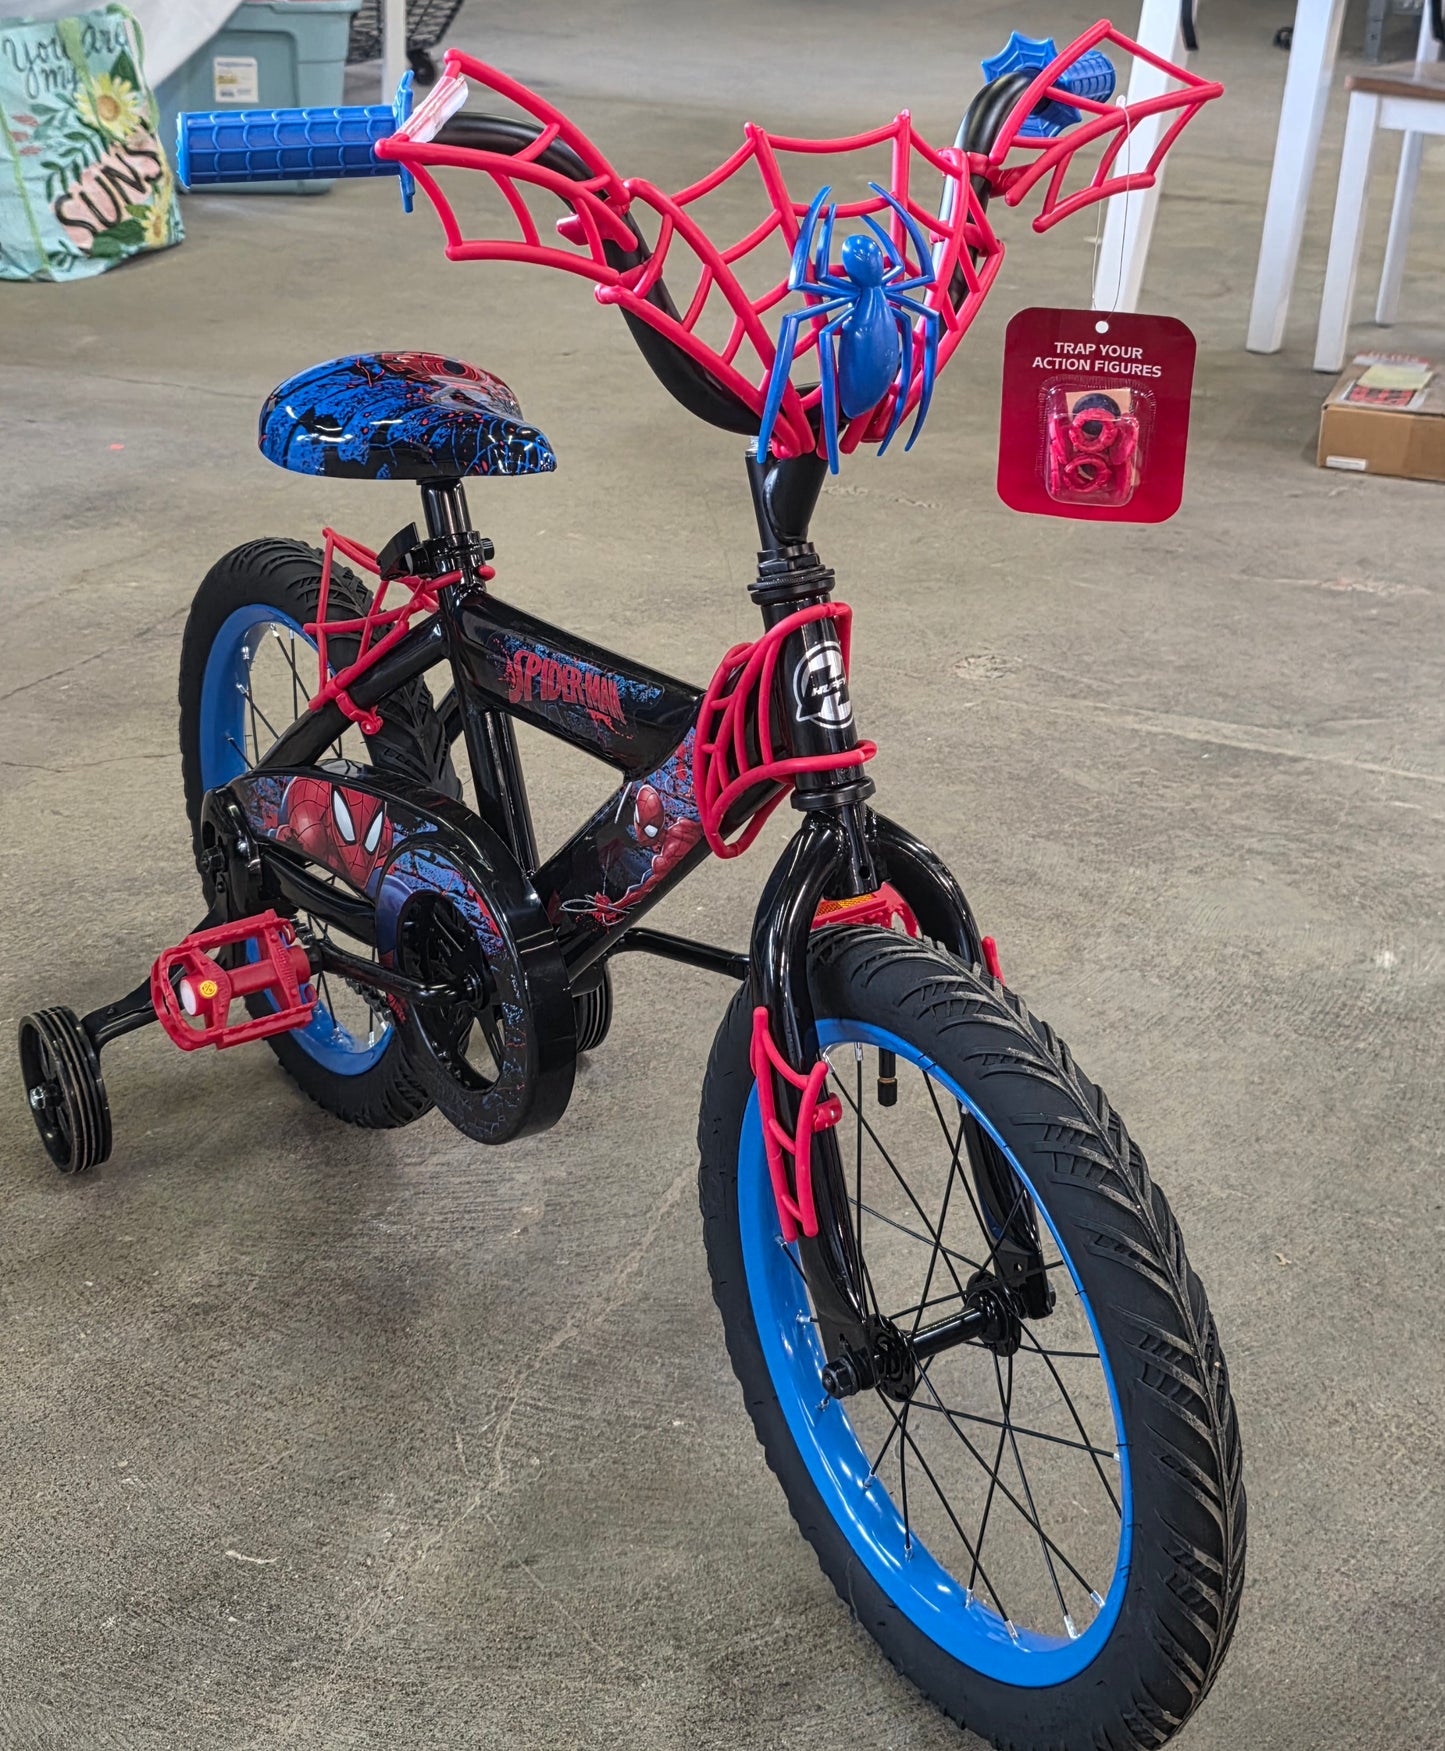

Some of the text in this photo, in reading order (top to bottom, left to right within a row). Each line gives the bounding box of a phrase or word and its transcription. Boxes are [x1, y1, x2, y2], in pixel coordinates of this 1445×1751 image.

[3, 37, 72, 100] You
[41, 65, 79, 102] my
[1032, 356, 1162, 378] ACTION FIGURES
[1054, 341, 1143, 360] TRAP YOUR
[508, 649, 627, 726] SPIDER-MAN
